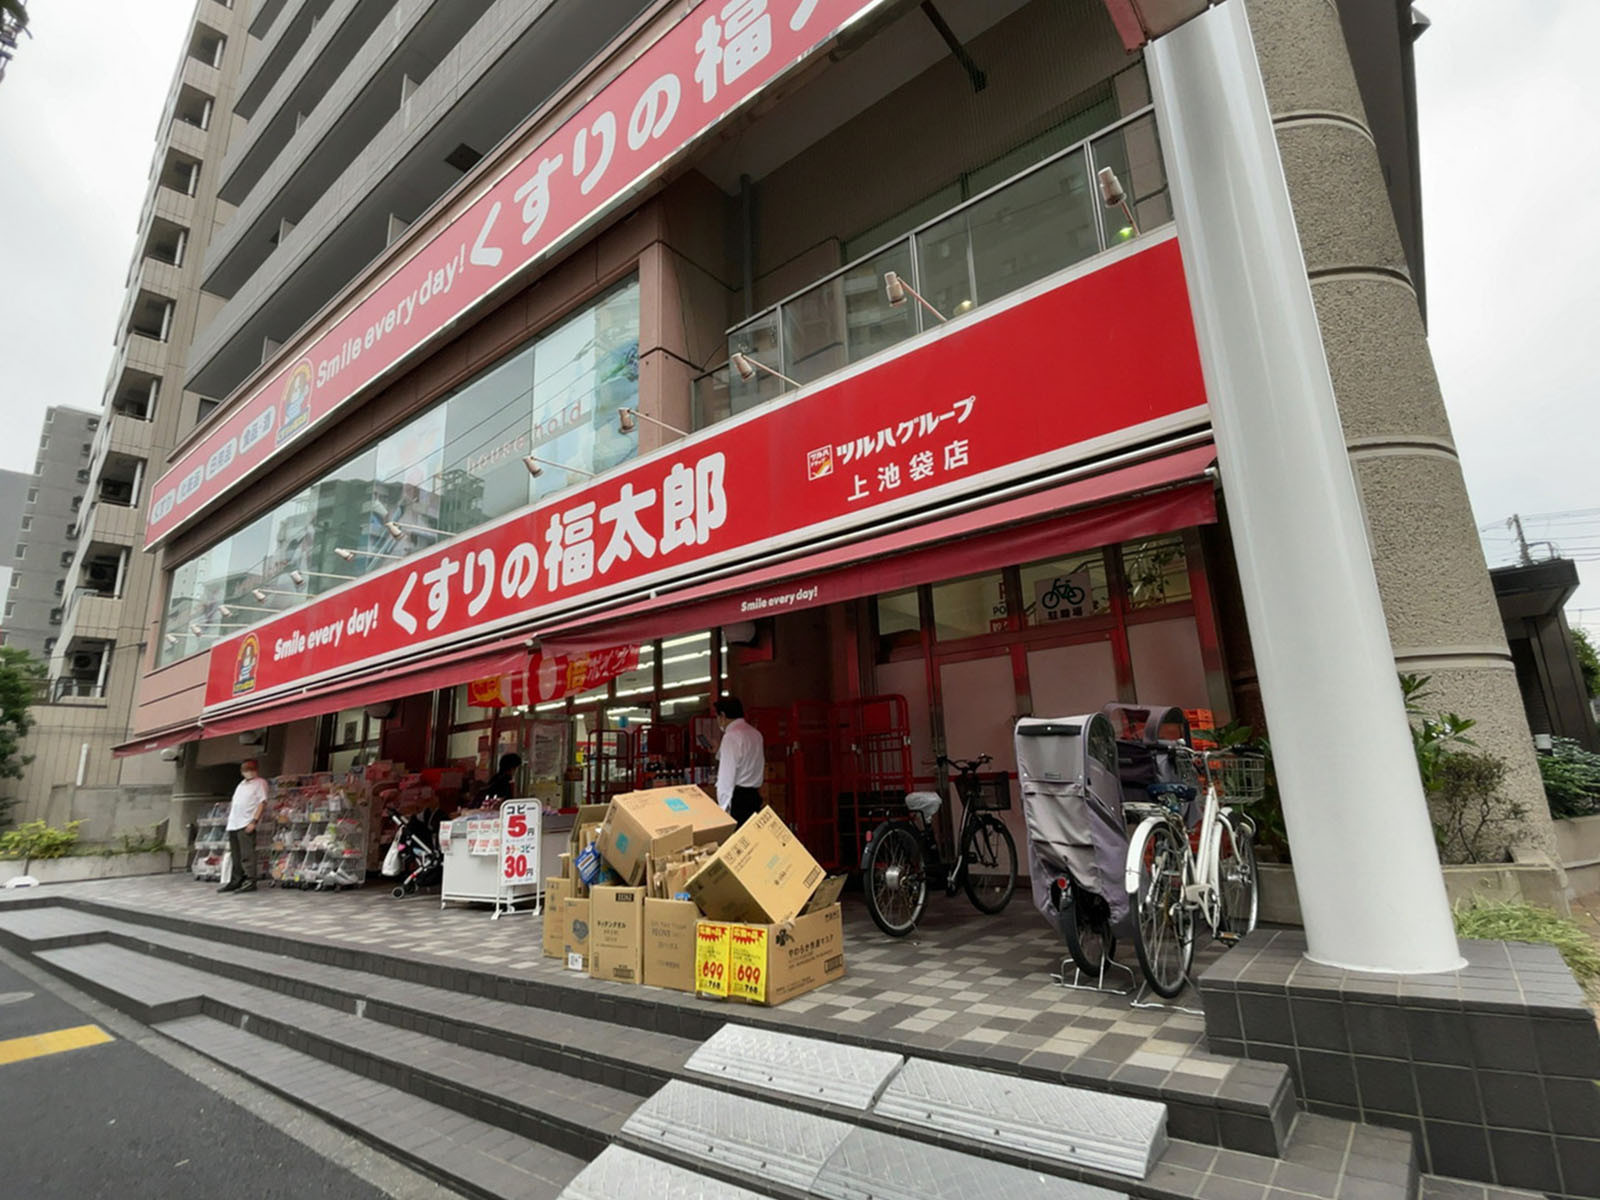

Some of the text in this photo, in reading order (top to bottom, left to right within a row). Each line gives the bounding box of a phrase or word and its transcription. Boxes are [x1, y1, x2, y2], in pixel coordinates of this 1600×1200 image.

[469, 0, 820, 267] くすりの福
[316, 243, 466, 388] Smile every day!
[836, 395, 976, 465] ツルハグループ
[847, 439, 969, 502] 上池袋店
[391, 451, 728, 636] くすりの福太郎
[741, 585, 818, 612] Smile every day!
[273, 602, 379, 662] Smile every day!
[506, 804, 536, 815] コピー
[702, 959, 724, 980] 699
[736, 964, 761, 985] 699
